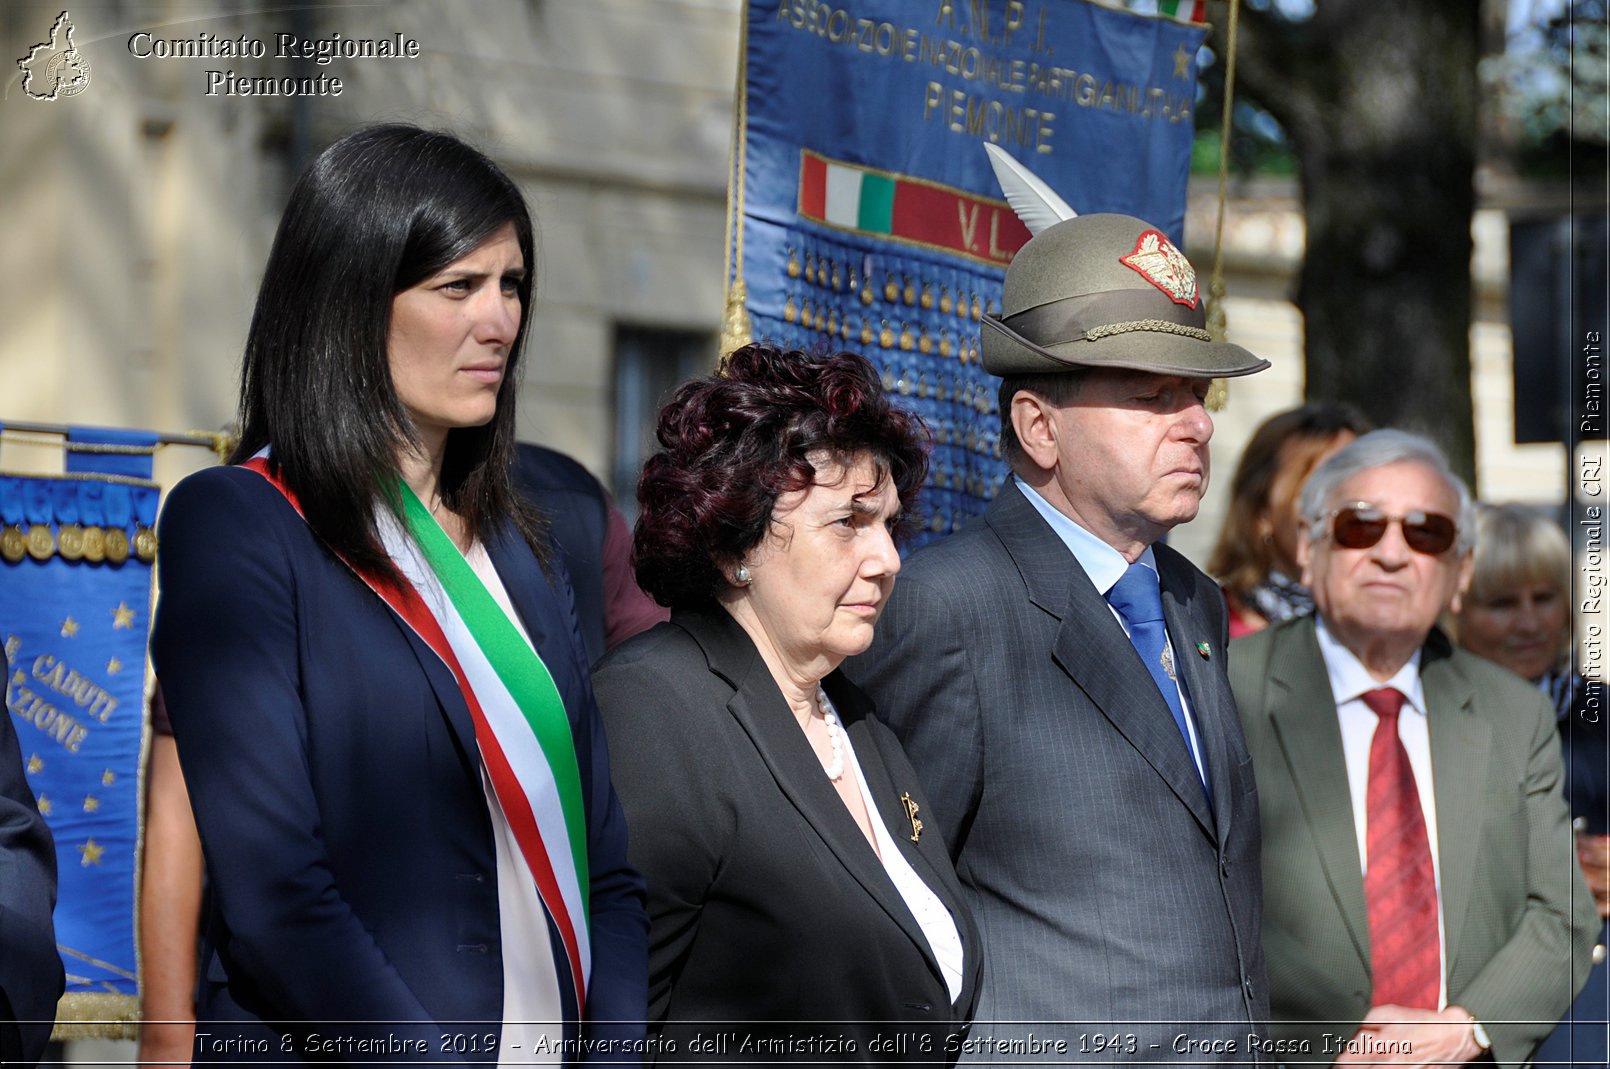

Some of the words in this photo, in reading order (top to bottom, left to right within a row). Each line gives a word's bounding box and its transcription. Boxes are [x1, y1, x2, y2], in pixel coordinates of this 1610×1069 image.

[776, 0, 919, 63] ASSOCIAZIONE
[919, 33, 1026, 93] NAZIONALE
[924, 81, 1057, 155] PIEMONTE
[32, 654, 119, 725] CADUTI
